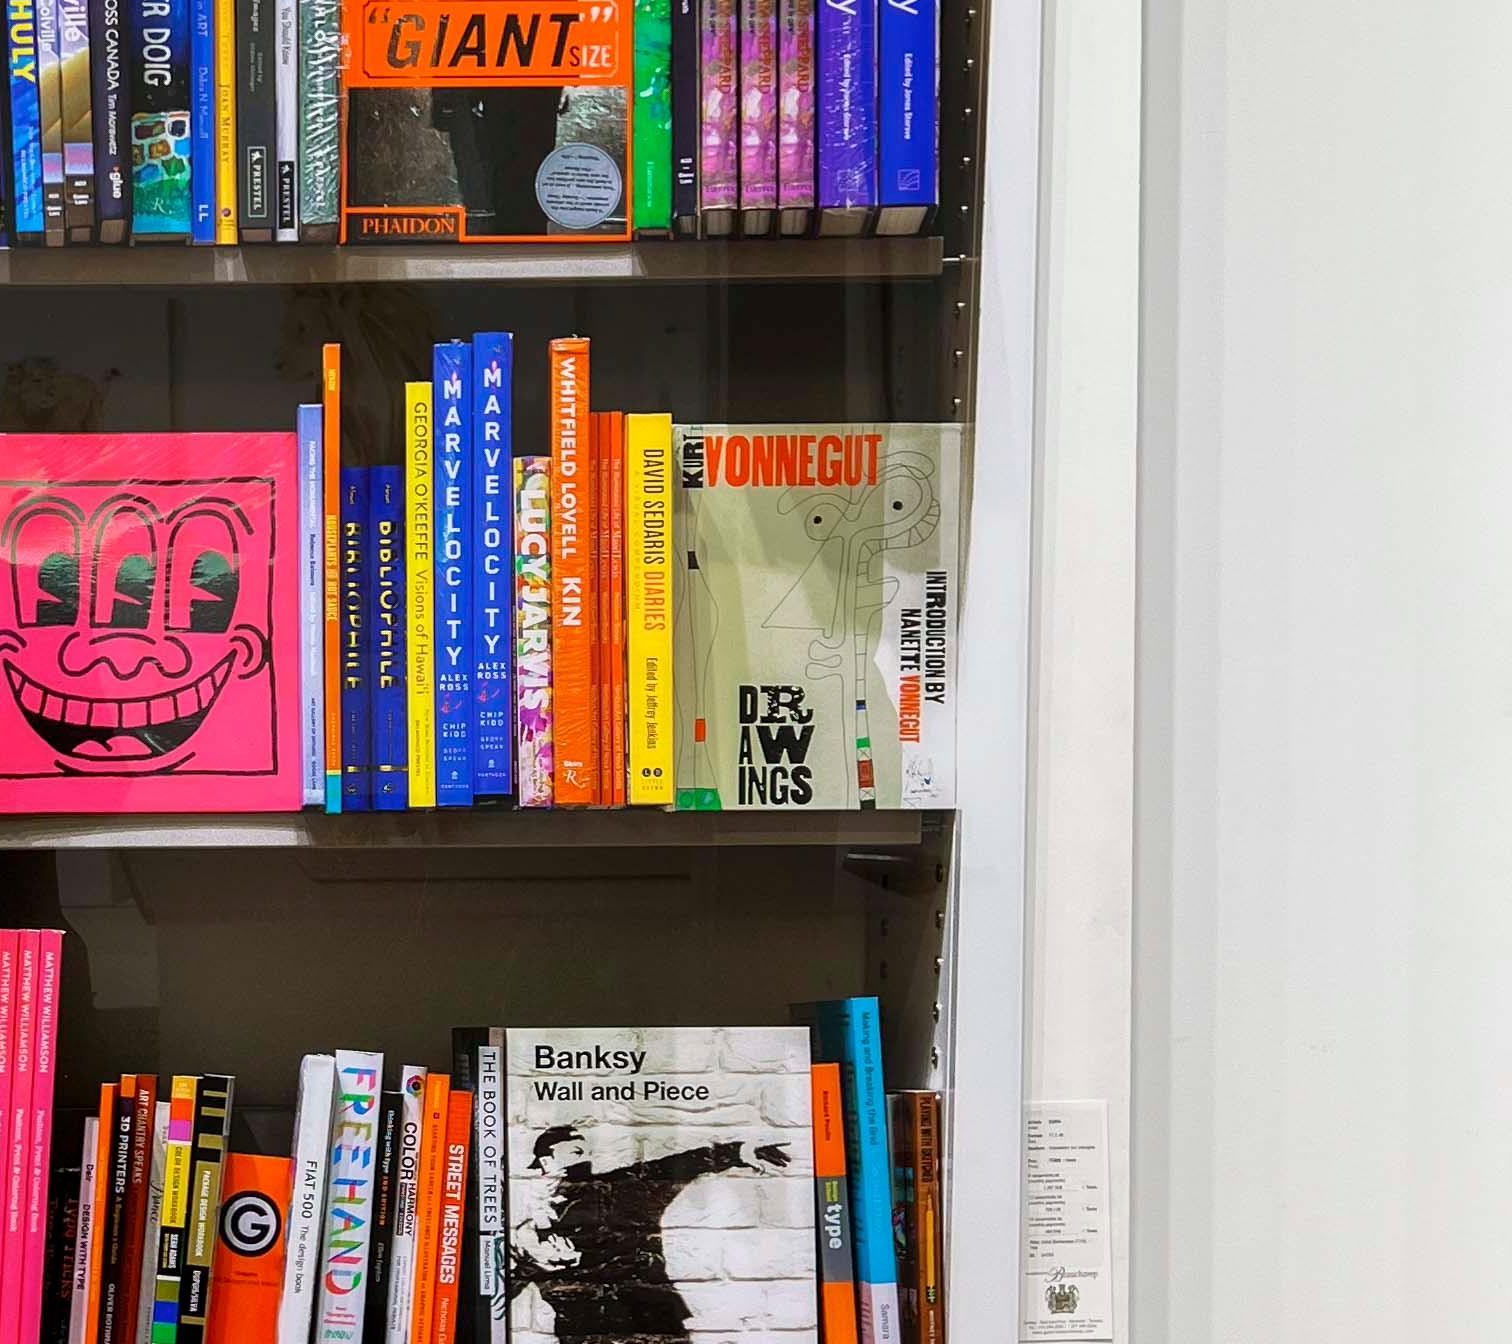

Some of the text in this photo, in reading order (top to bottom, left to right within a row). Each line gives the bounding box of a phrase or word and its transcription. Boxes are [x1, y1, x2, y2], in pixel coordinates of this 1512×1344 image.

[144, 27, 170, 86] DOIG
[570, 46, 611, 68] SIZE
[362, 218, 455, 234] PHAIDON
[559, 357, 581, 626] WHITFIELD LOVELL KIN
[682, 433, 704, 488] KURT
[705, 434, 883, 488] VONNEGUT
[442, 381, 461, 666] MARVELOCITY
[482, 367, 501, 654] MARVELOCITY
[643, 449, 666, 631] DAVID SEDARIS DIARIES
[521, 491, 551, 711] LUCY JARVIS
[925, 571, 947, 704] INTRODUCTION BY
[899, 608, 921, 743] NANETTE VONNEGUT
[739, 766, 813, 805] INGS
[534, 1045, 646, 1073] Banksy
[534, 1082, 709, 1101] Wall and Piece
[483, 1052, 497, 1222] THE BOOK OF TREES
[301, 1160, 317, 1218] FIAT 500
[439, 1145, 464, 1284] STREET MESSAGES
